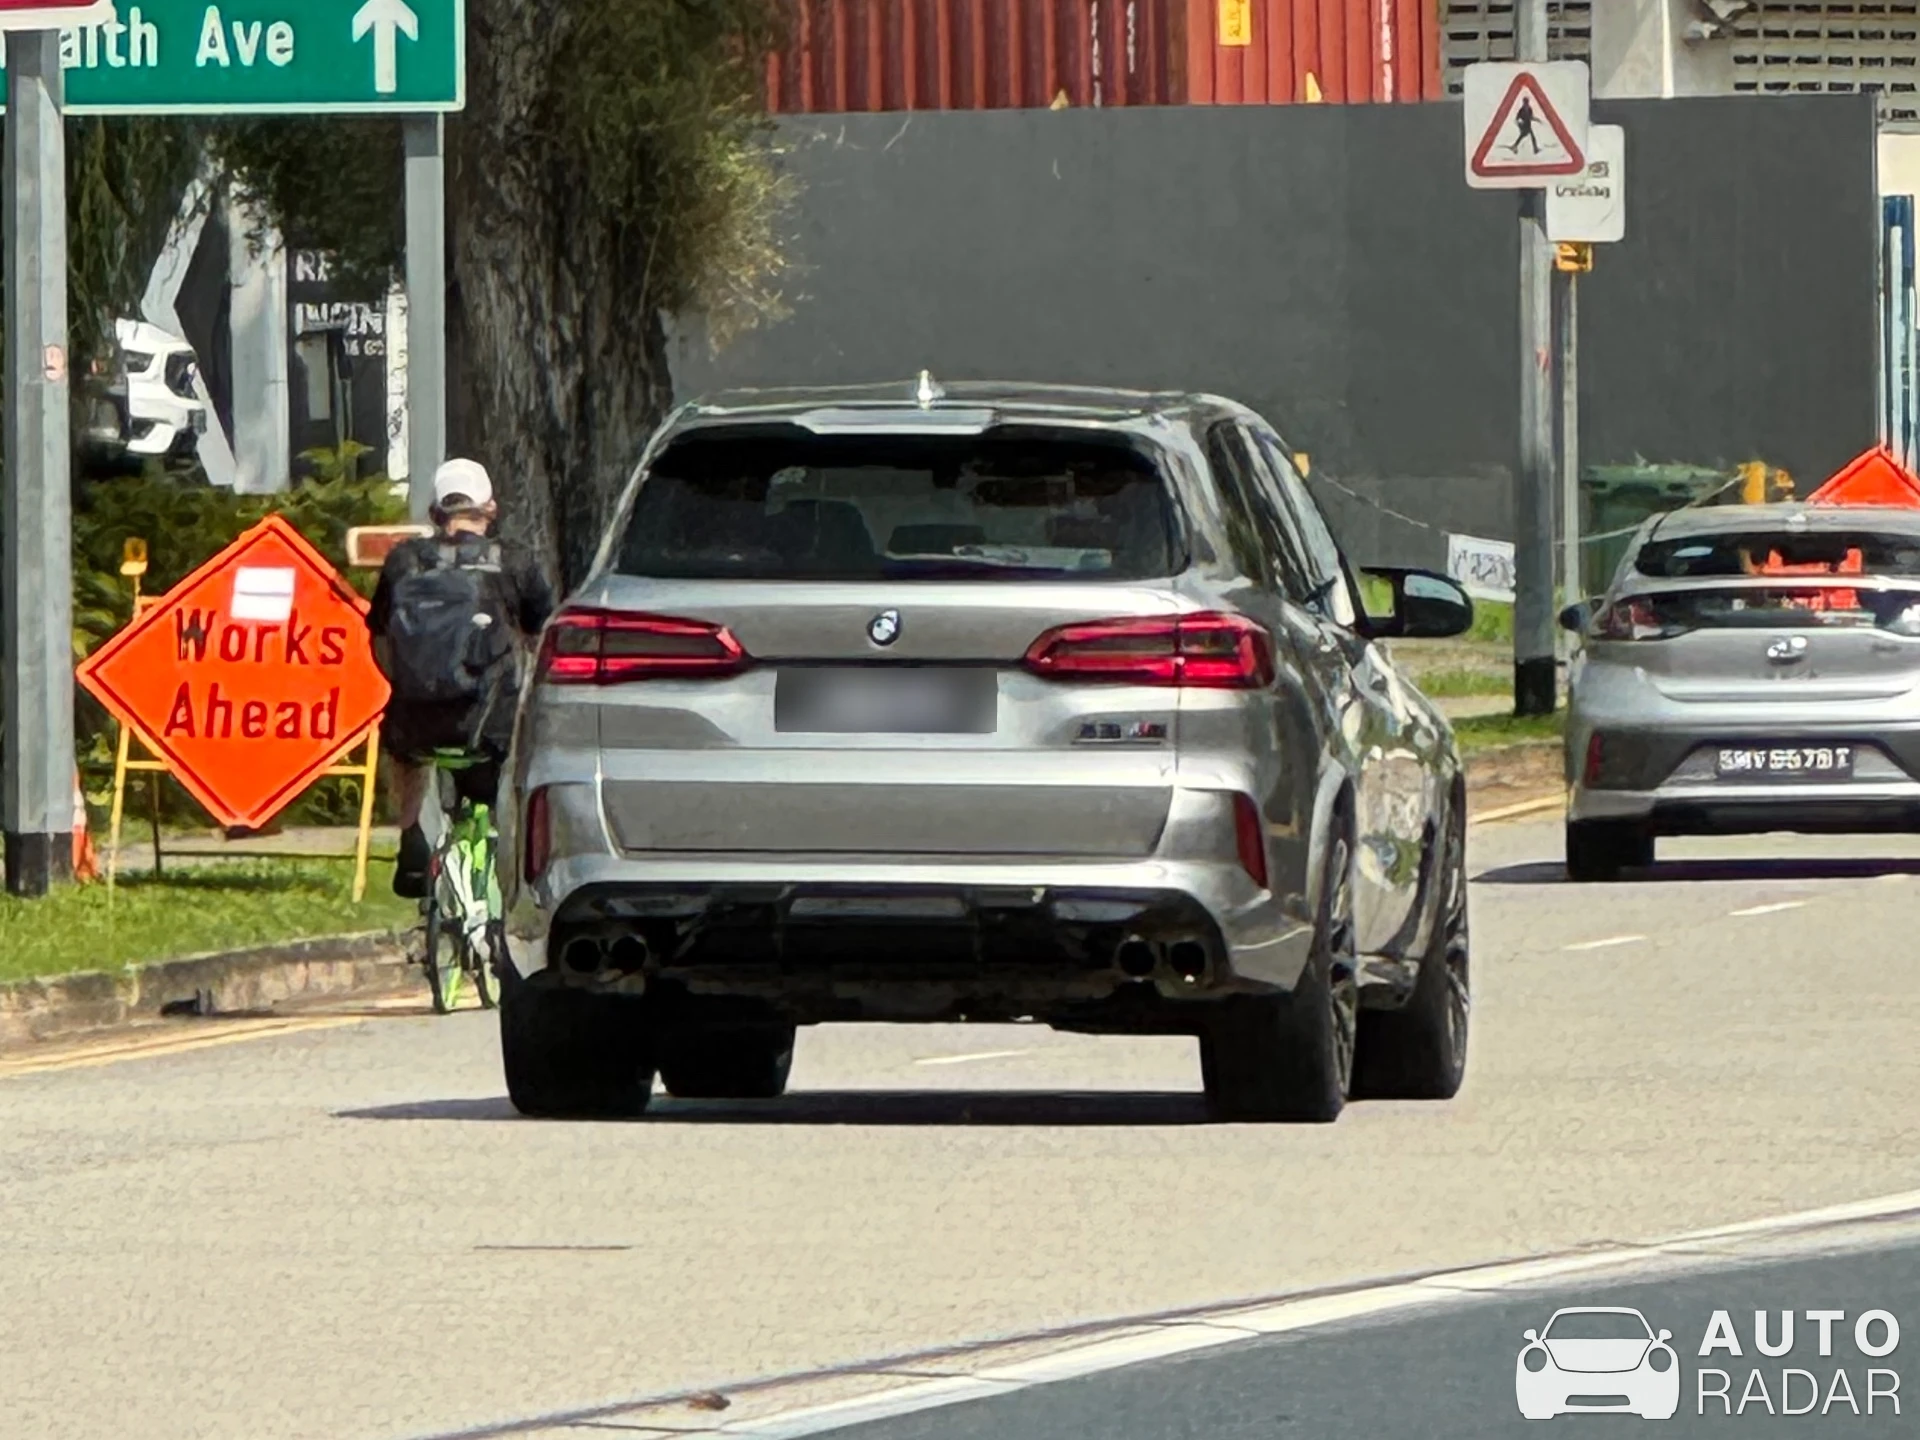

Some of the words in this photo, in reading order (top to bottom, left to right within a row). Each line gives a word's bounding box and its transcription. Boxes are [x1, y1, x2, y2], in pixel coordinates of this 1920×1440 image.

[0, 6, 158, 68] alth
[196, 5, 294, 67] Ave
[175, 608, 347, 665] Works
[164, 681, 340, 740] Ahead
